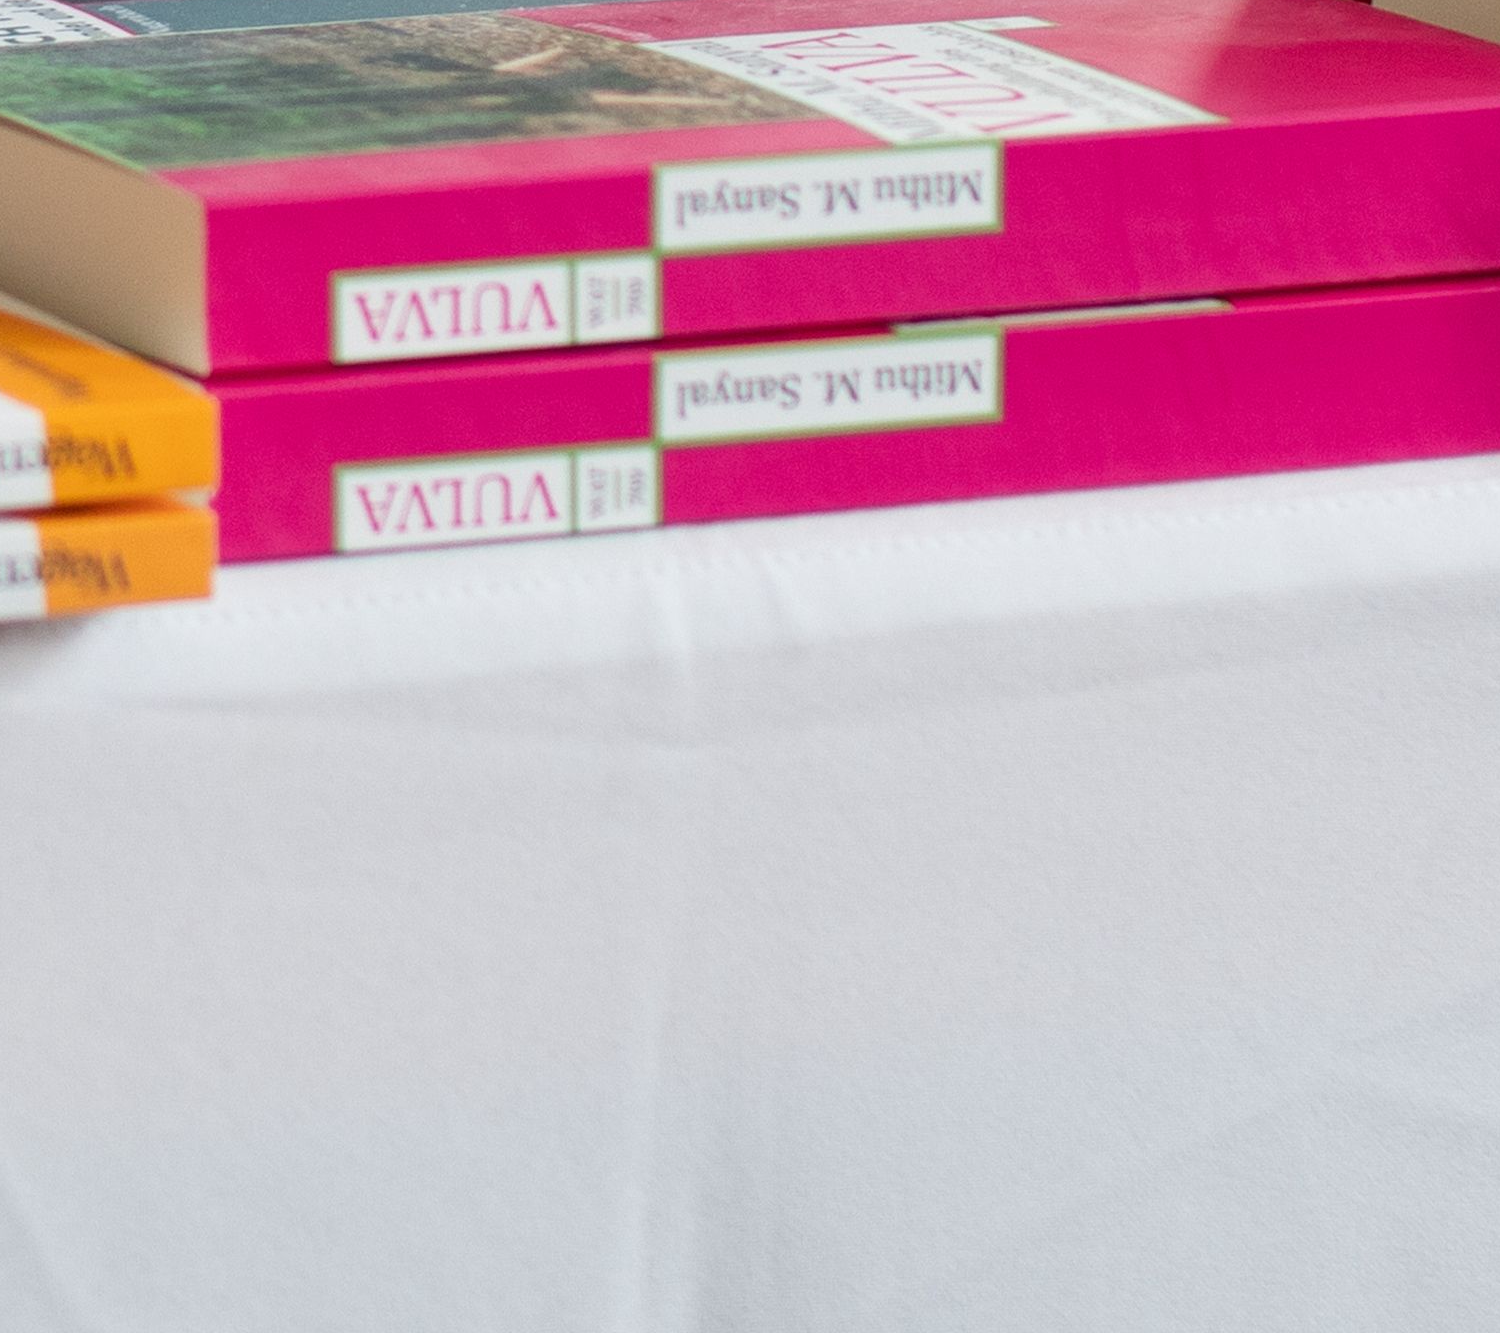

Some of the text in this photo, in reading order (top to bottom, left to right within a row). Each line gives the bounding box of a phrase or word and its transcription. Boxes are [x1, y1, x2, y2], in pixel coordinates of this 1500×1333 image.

[761, 32, 1075, 133] VULVA
[675, 170, 984, 229] Mithu M. Sanyal
[354, 280, 561, 343] VULVA
[676, 359, 984, 419] Mithu M. Sanyal
[355, 472, 562, 534] VULVA
